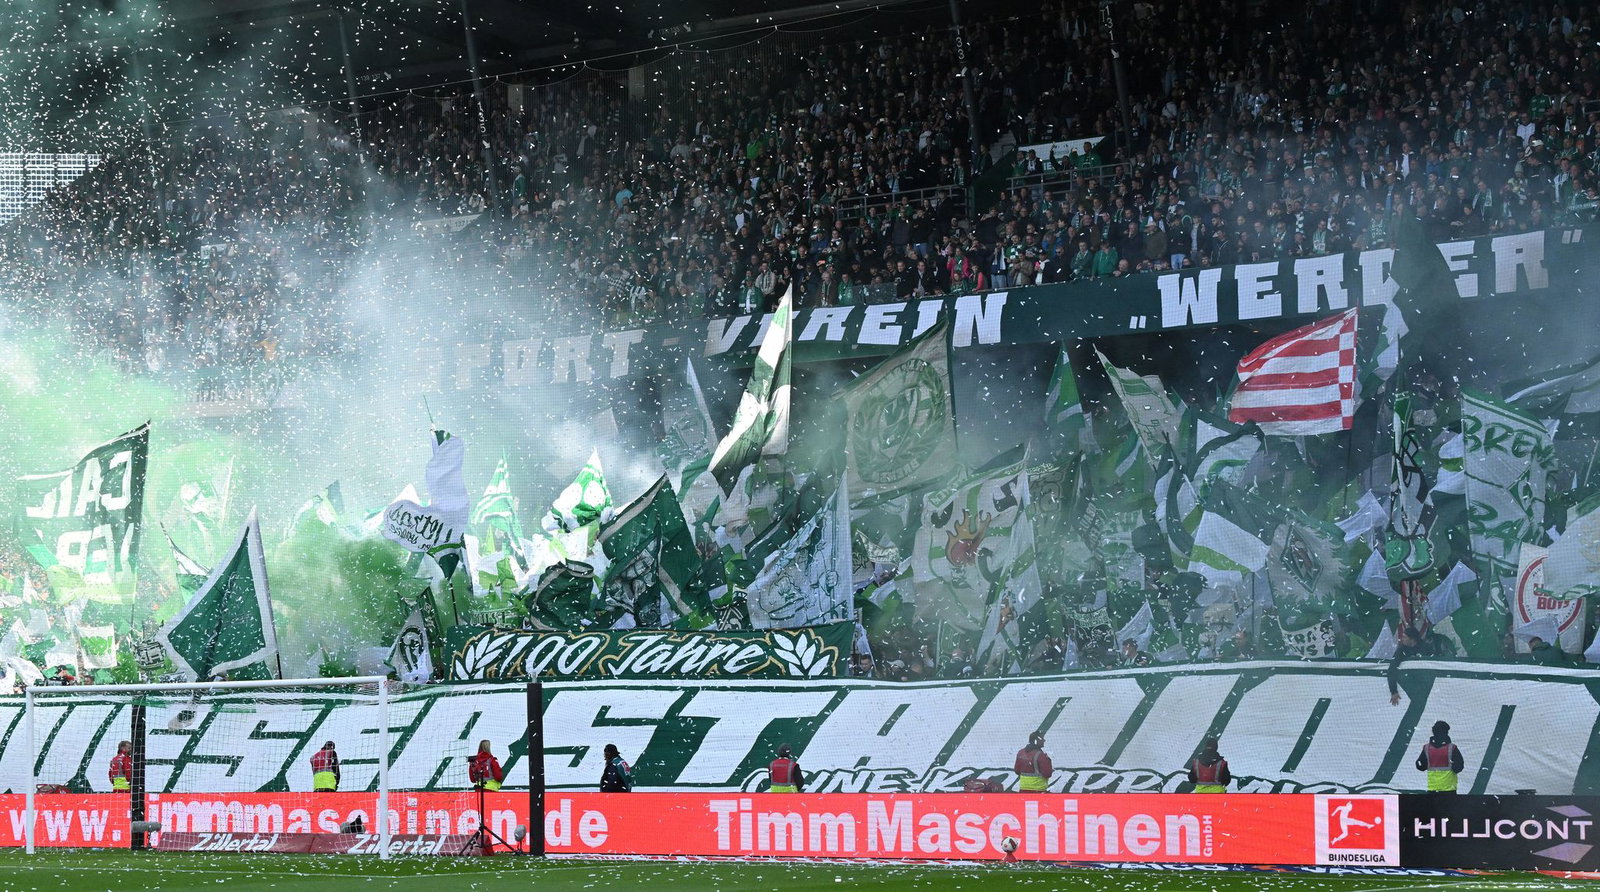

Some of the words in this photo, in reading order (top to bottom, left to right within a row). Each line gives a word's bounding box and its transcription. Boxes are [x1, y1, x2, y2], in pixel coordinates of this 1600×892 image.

[499, 632, 602, 676] 100
[608, 632, 769, 676] Jahre
[9, 793, 609, 848] www.immmaschinende
[188, 833, 279, 852] Zillertal
[709, 798, 856, 854] Timm
[866, 799, 1201, 858] Maschinen
[1202, 814, 1213, 857] GmbH
[1328, 853, 1386, 863] BUNDESLIGA
